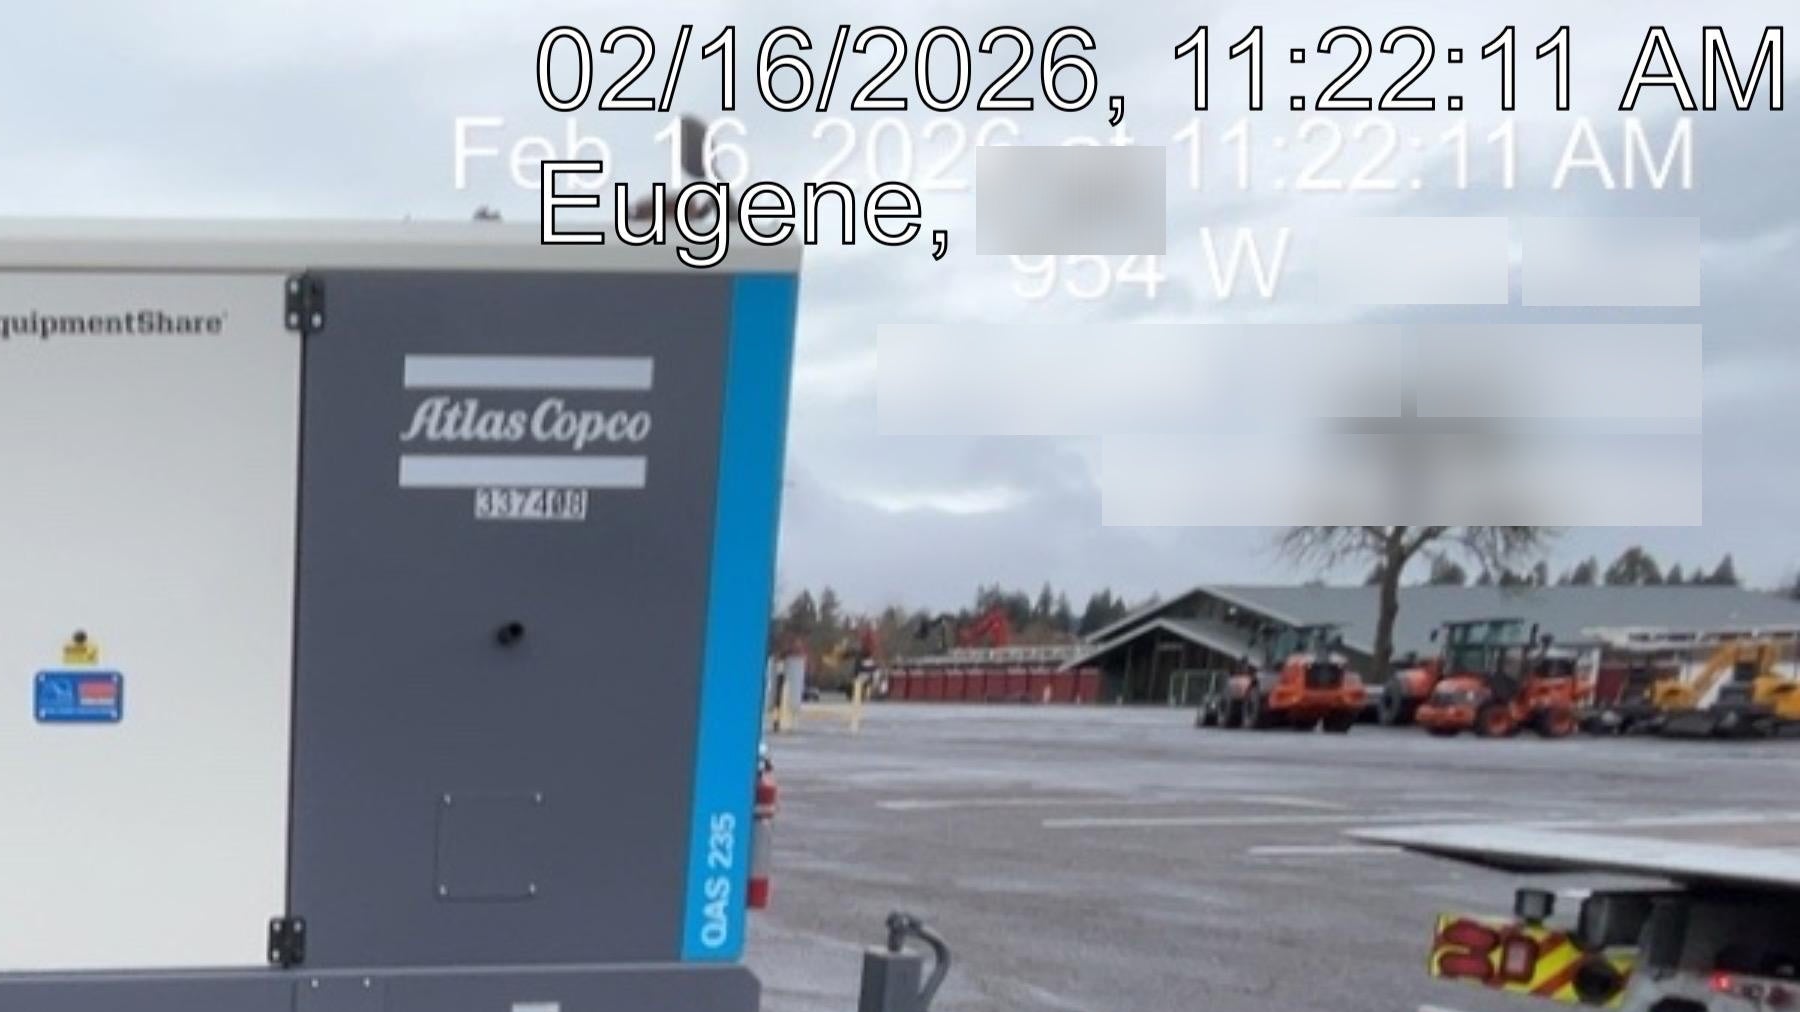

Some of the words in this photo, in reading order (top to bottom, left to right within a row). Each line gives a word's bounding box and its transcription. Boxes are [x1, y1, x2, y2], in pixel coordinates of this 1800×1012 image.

[399, 395, 528, 442] Atlas
[529, 396, 653, 452] Copco
[707, 811, 737, 870] 235
